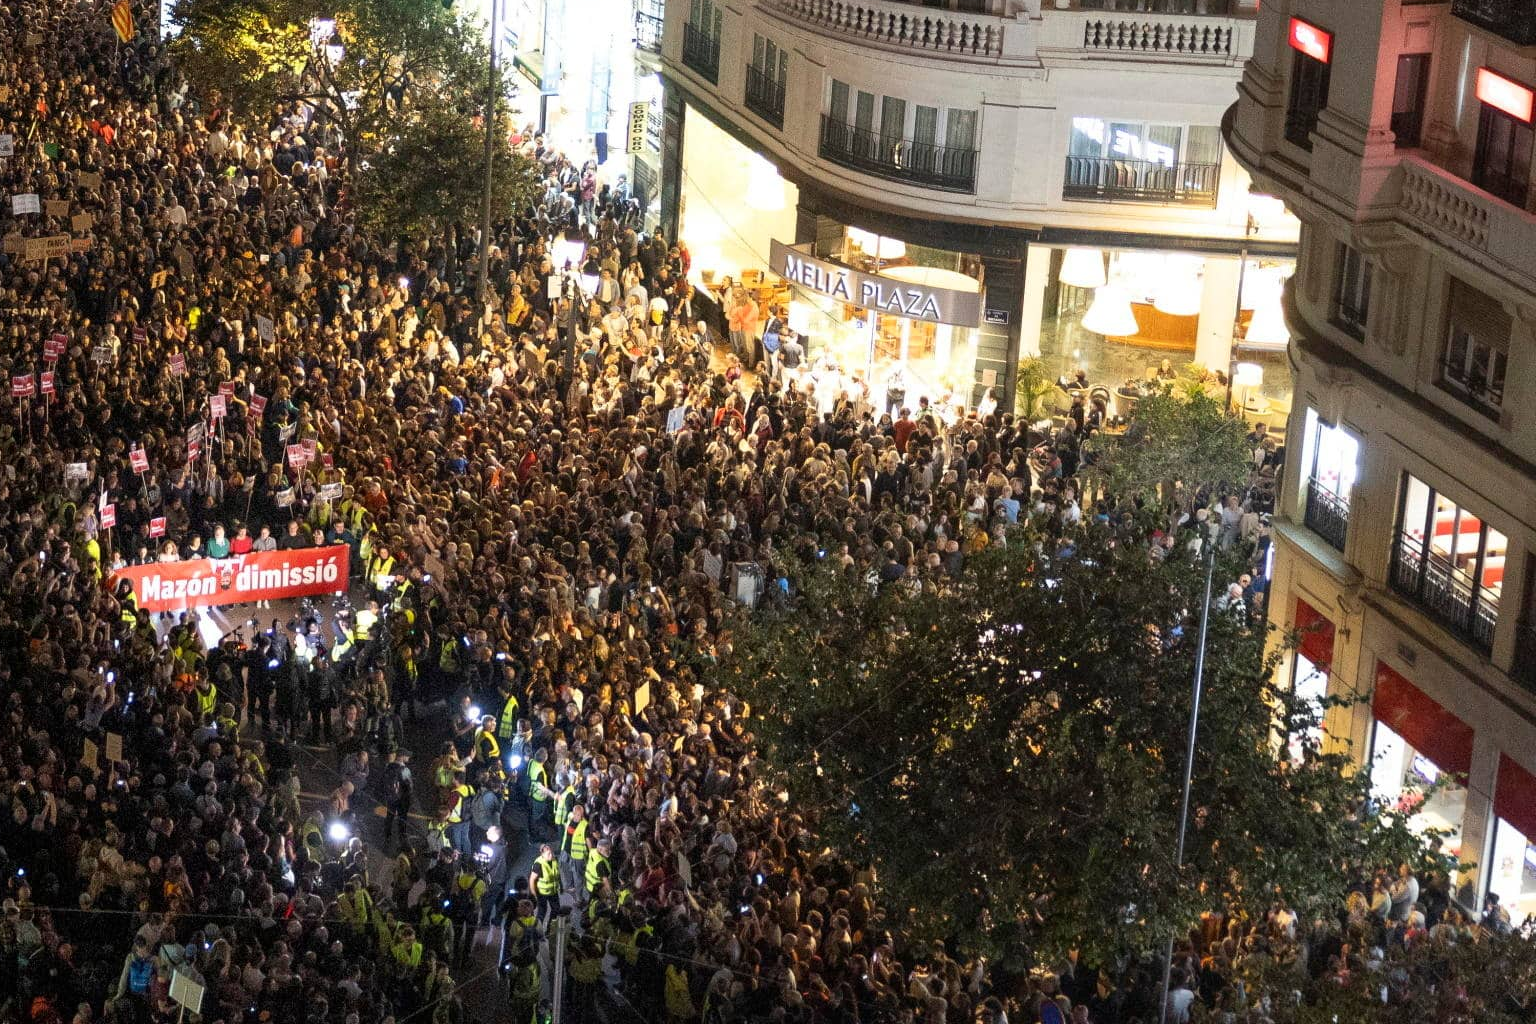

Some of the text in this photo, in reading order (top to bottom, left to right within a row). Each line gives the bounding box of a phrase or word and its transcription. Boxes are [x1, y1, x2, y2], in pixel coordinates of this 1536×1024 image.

[631, 105, 644, 151] COMPRO ORO
[861, 280, 941, 319] PLAZA
[141, 556, 338, 603] Mazón dimissió
